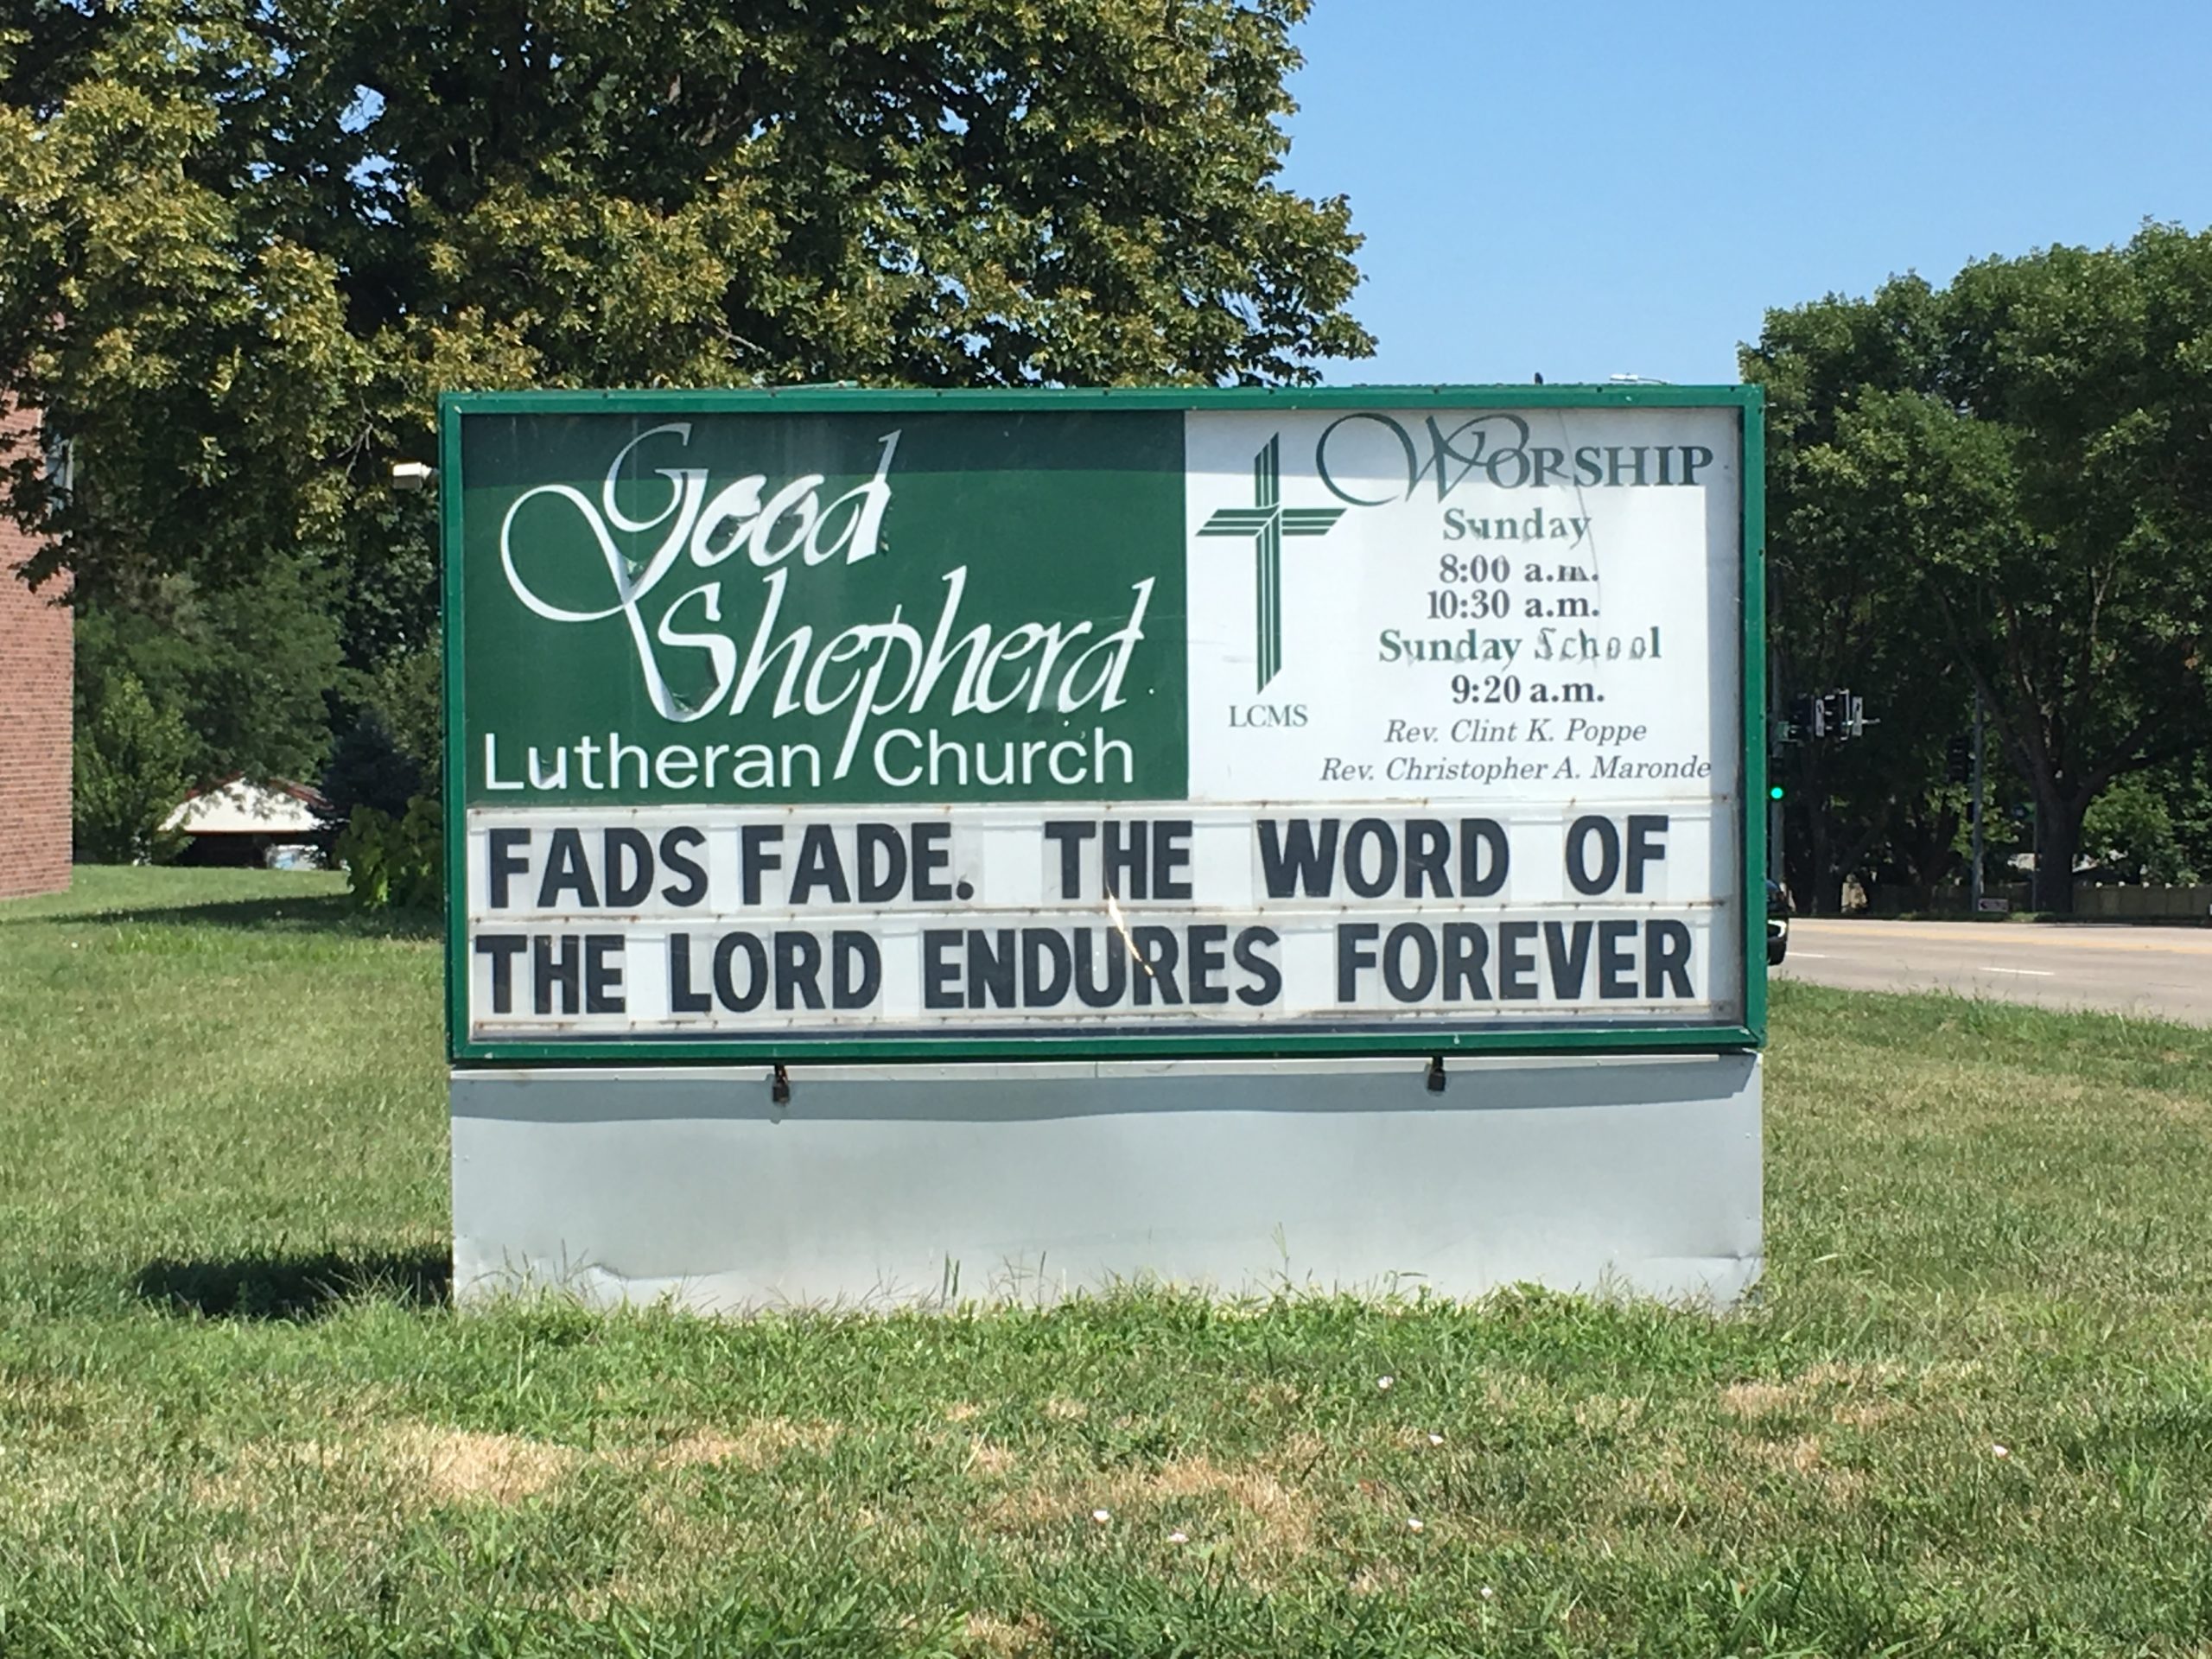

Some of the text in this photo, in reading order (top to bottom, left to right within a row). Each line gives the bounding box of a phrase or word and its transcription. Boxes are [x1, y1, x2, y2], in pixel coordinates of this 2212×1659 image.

[500, 423, 902, 624] Good
[1442, 508, 1592, 549] Sunday
[1440, 555, 1599, 584] 8:00 a.m.
[1427, 590, 1601, 620] 10:30 a.m.
[1379, 626, 1662, 671] Sunday School
[658, 565, 1155, 780] Shepherd
[1451, 675, 1605, 705] 9:20 a.m.
[1229, 704, 1308, 728] LCMS
[1384, 719, 1647, 747] Rev. Clint K. Poppe
[486, 728, 1134, 791] Lutheran Church
[1319, 753, 1712, 786] Rev. Christopher A. Maronde
[489, 815, 1669, 909] FADS FADE. THE WORD OF
[475, 919, 1695, 1014] THE LORD ENDURES FOREVER
